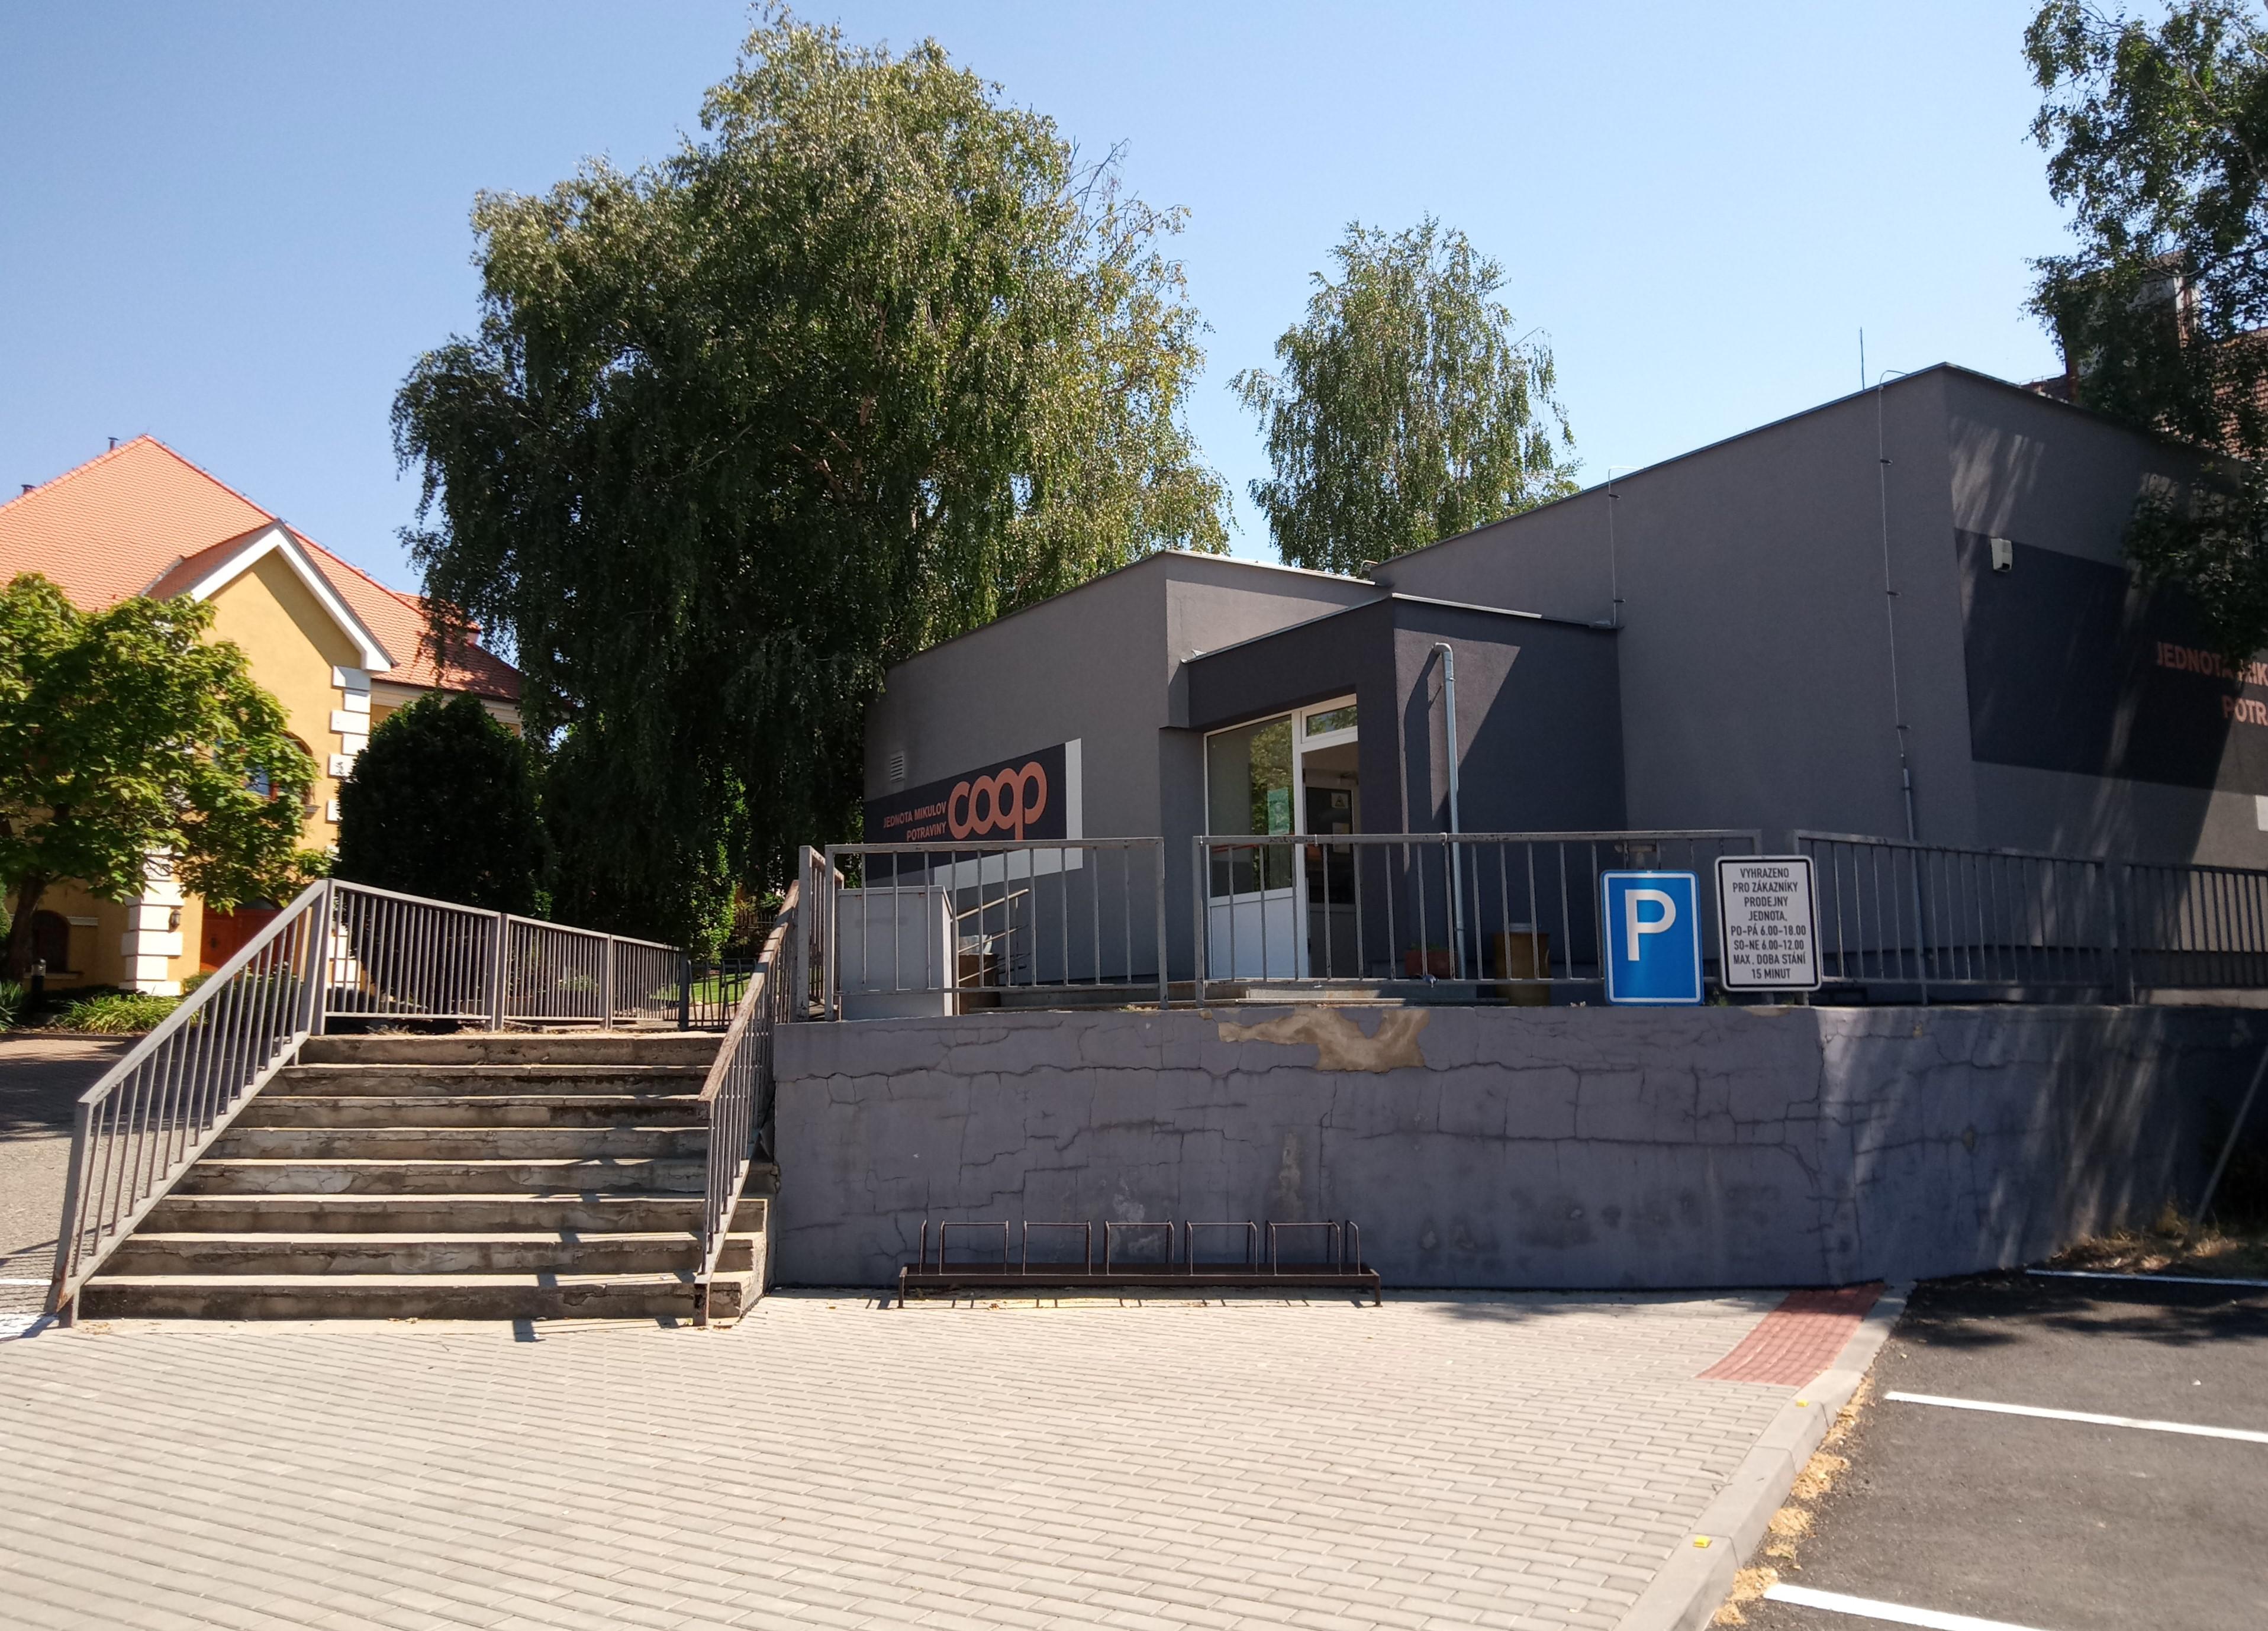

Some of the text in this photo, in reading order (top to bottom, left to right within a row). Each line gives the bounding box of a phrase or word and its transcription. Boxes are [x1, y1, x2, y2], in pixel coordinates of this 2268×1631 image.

[884, 801, 947, 829] JEDNOTA MIKULOV
[906, 821, 947, 842] POTRAVINY
[1740, 868, 1789, 878] VYHRAZENO
[1732, 879, 1798, 892] PRO ZÁKAZNÍKY
[1744, 897, 1788, 907] PRODEJNY
[1625, 889, 1676, 962] P
[1731, 923, 1758, 936] PO-PÁ
[1734, 940, 1760, 950] SO-NE
[1757, 954, 1780, 964] DOBA
[1781, 951, 1806, 964] STÁNÍ
[1751, 968, 1791, 979] 15 MINUT
